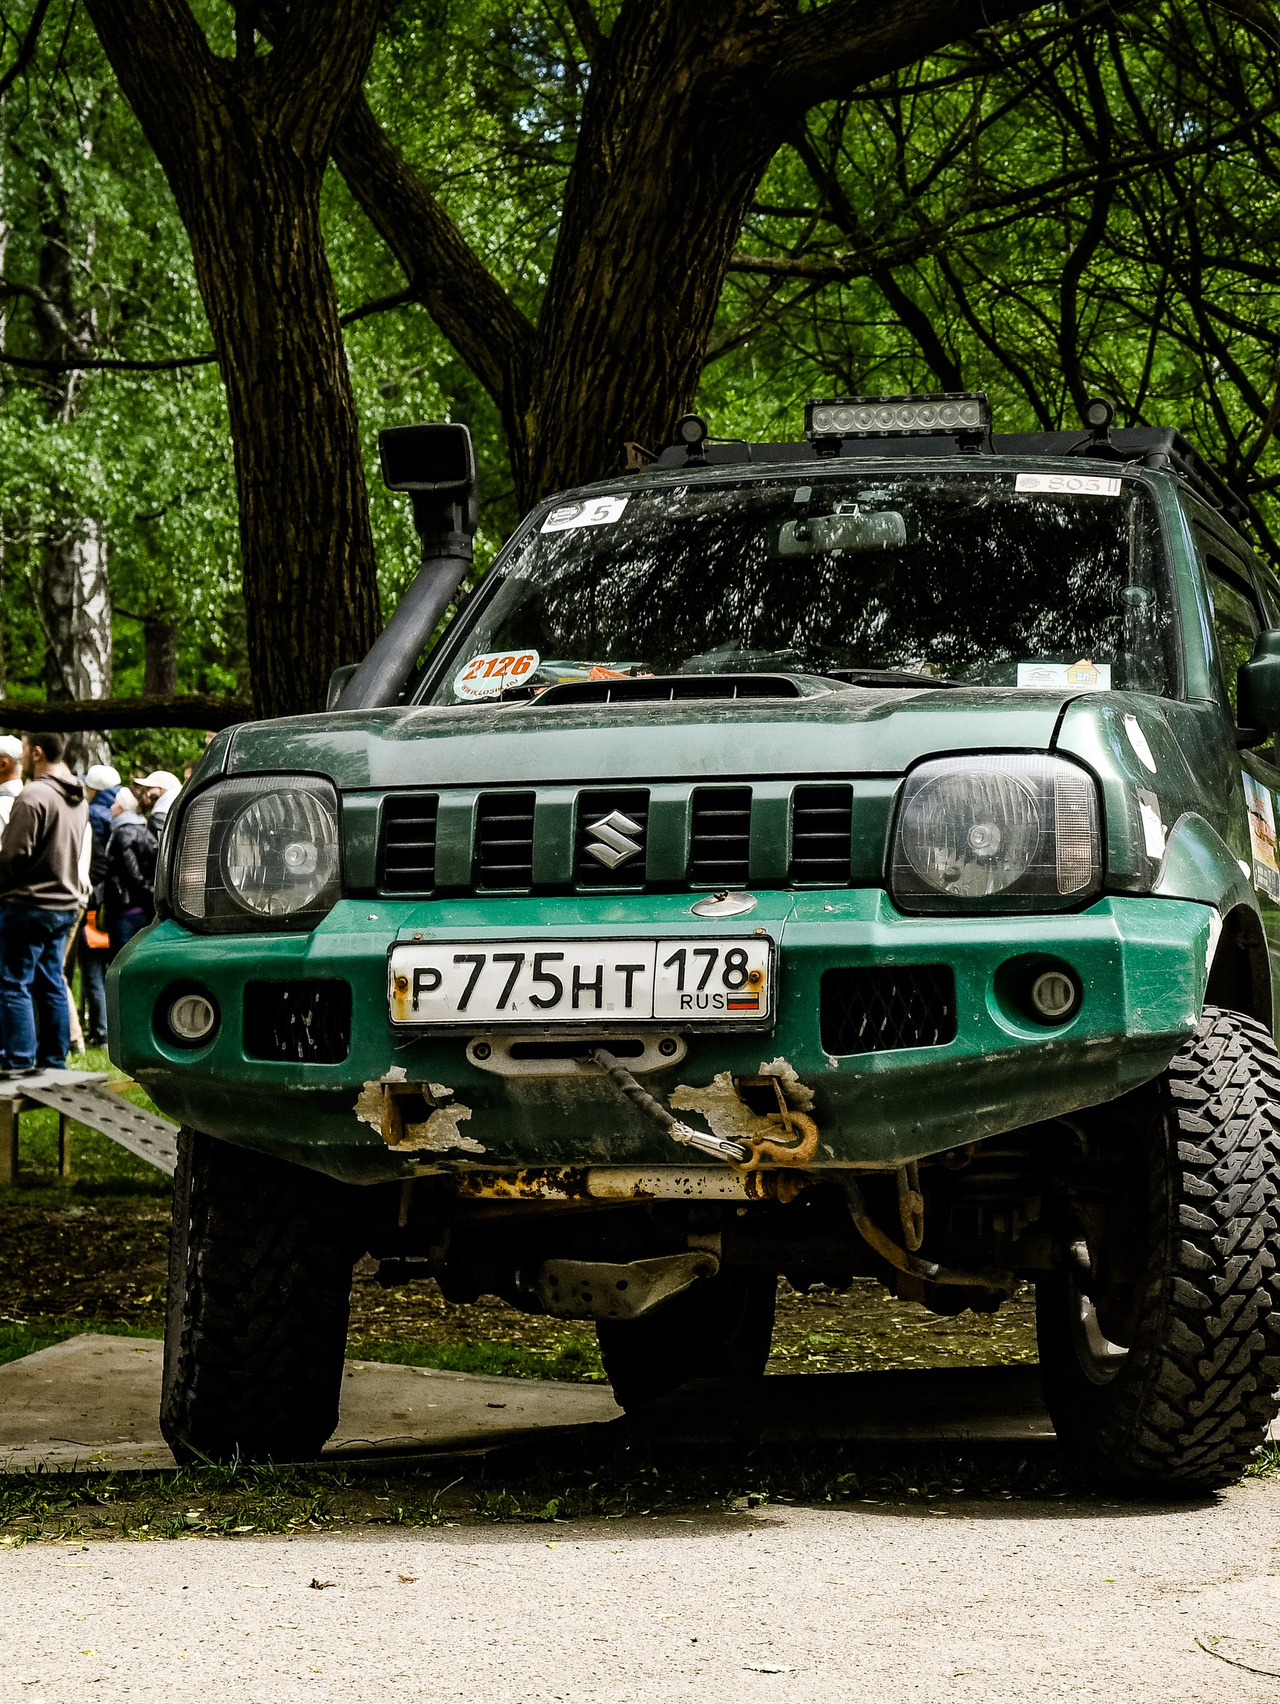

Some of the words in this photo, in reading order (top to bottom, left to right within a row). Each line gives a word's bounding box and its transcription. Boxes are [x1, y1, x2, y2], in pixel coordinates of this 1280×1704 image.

[1048, 477, 1101, 492] 805
[591, 504, 612, 522] 5
[462, 655, 534, 681] 2126
[413, 951, 646, 1012] Р775НТ
[663, 948, 749, 991] 178
[680, 993, 724, 1010] RUS
